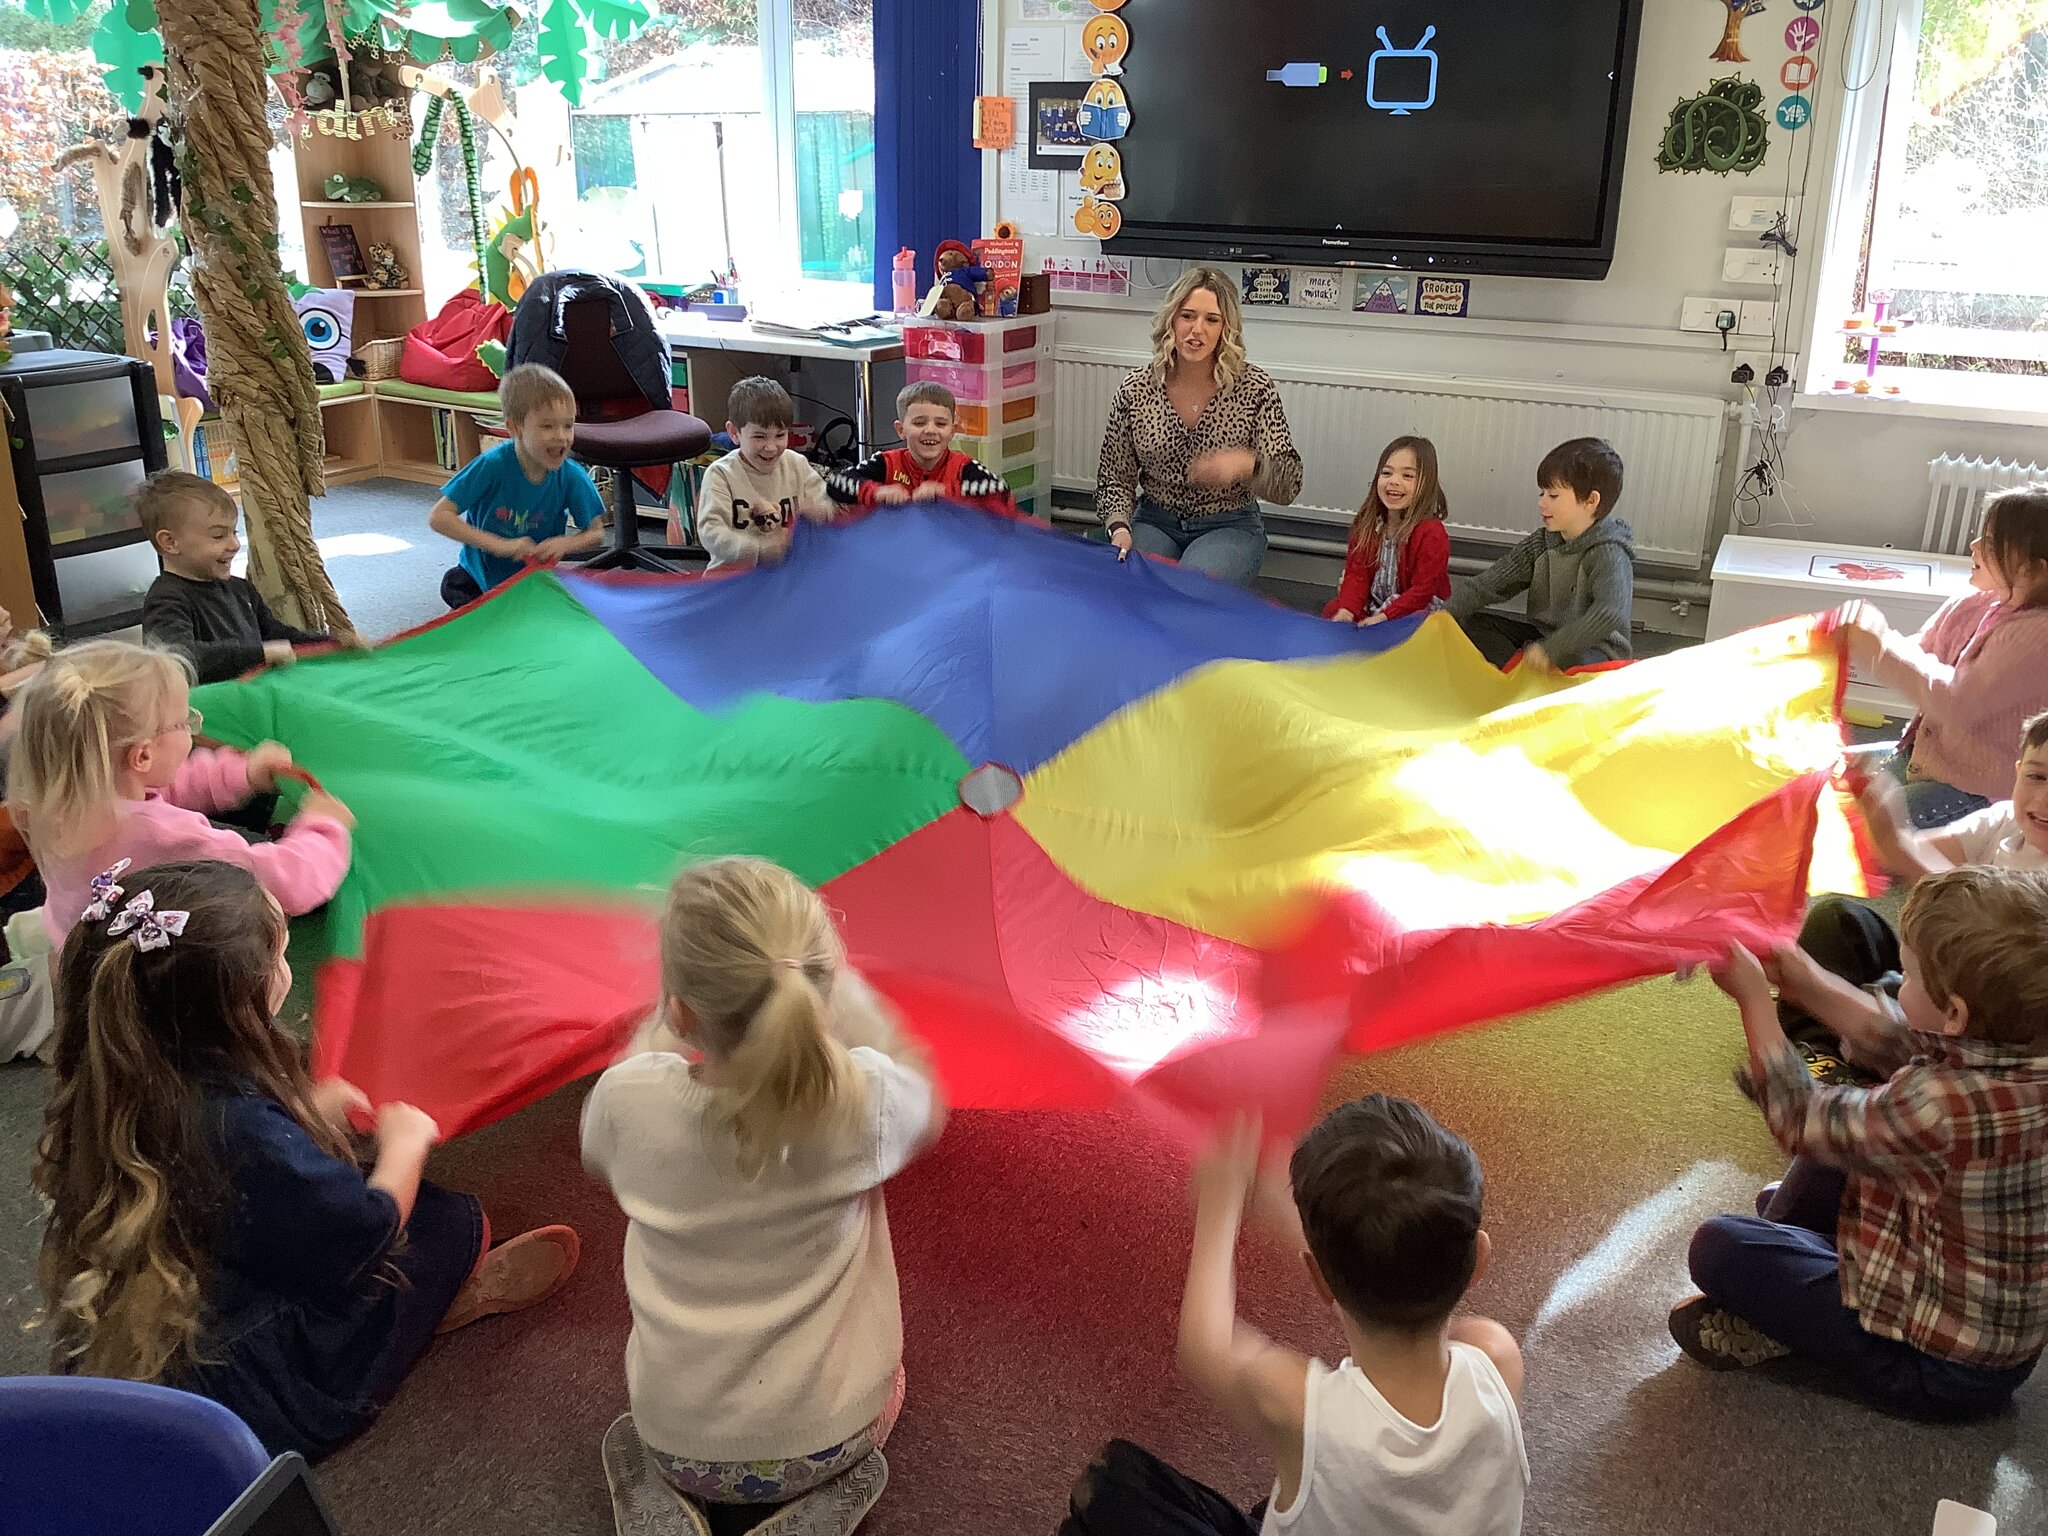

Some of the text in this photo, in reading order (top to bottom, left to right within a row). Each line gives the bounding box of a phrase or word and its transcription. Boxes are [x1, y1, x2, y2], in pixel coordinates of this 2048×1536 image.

[1255, 279, 1278, 287] GOING
[1309, 277, 1331, 287] make
[1424, 282, 1462, 294] PROGRESS
[1250, 291, 1282, 300] GROWING
[1424, 301, 1458, 313] not perfect
